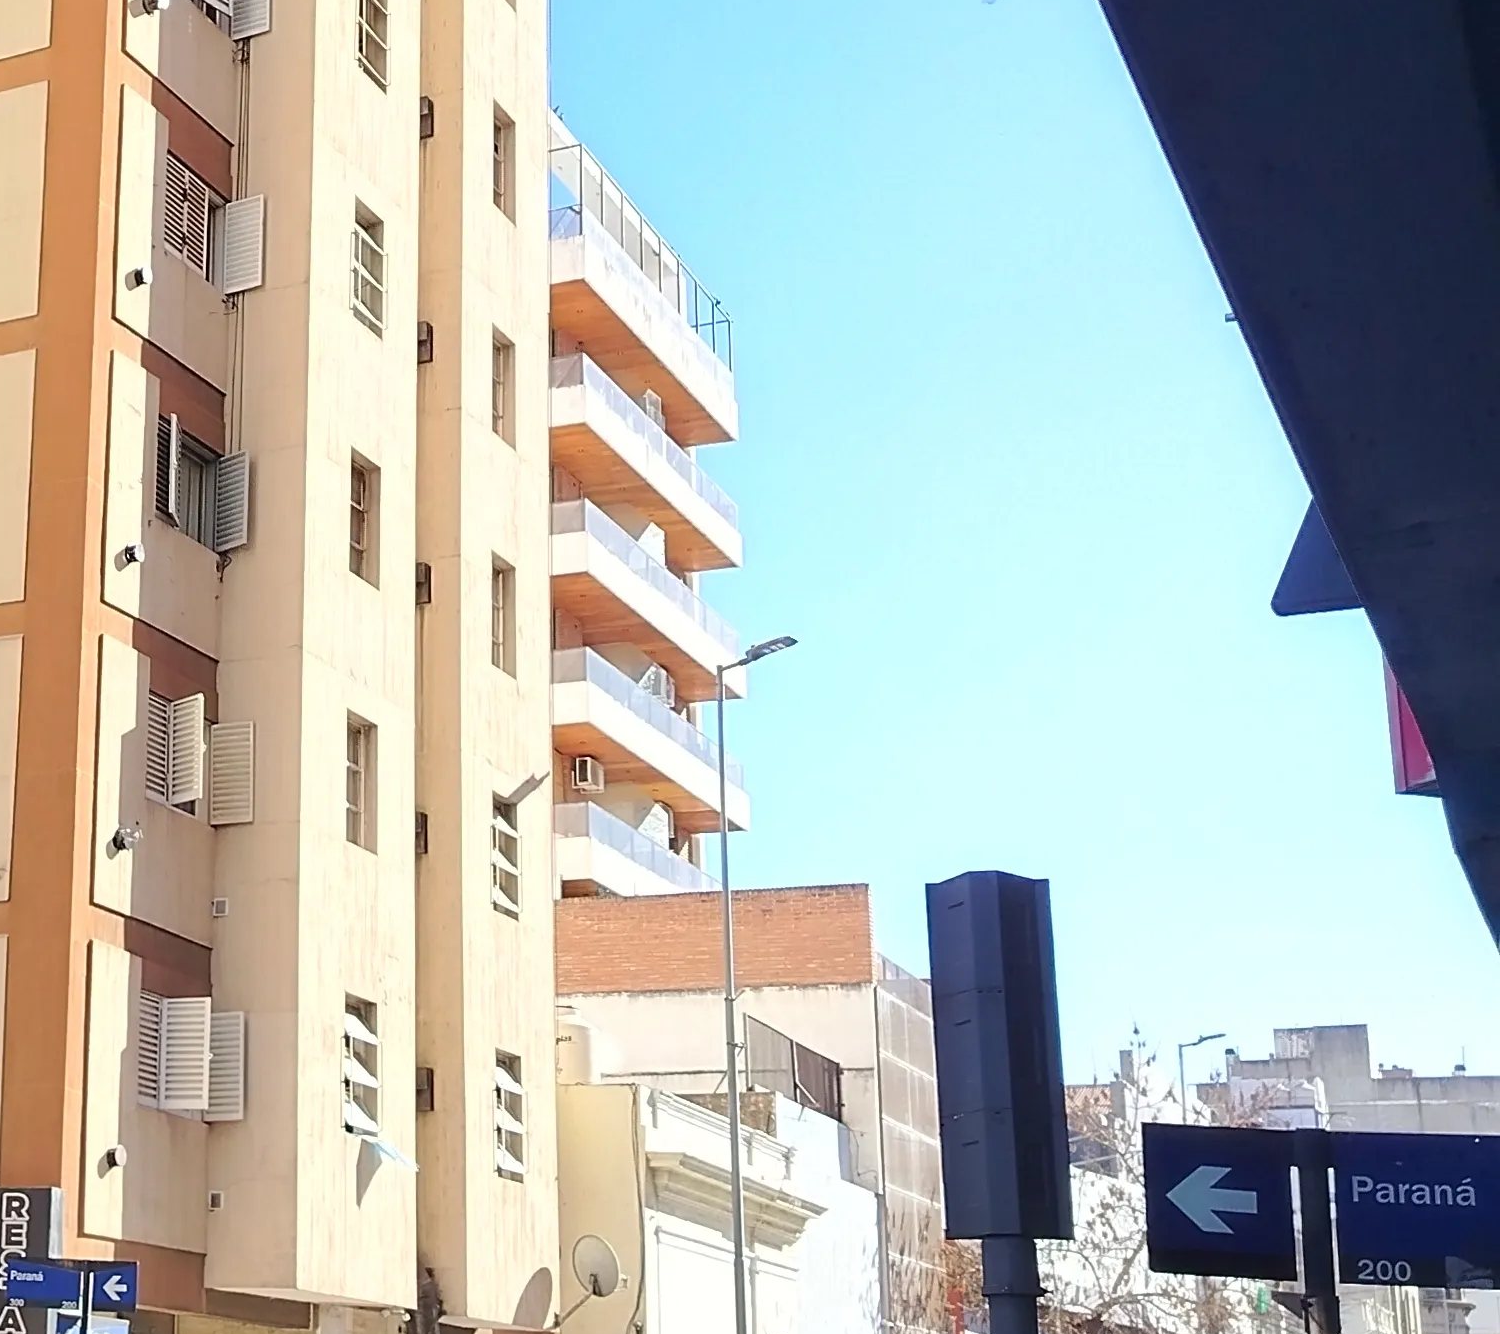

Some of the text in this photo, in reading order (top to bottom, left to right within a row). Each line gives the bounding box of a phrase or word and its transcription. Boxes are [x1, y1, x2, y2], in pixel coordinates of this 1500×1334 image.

[1351, 1175, 1476, 1207] Paraná
[10, 1270, 44, 1282] Paraná
[1357, 1259, 1412, 1282] 200
